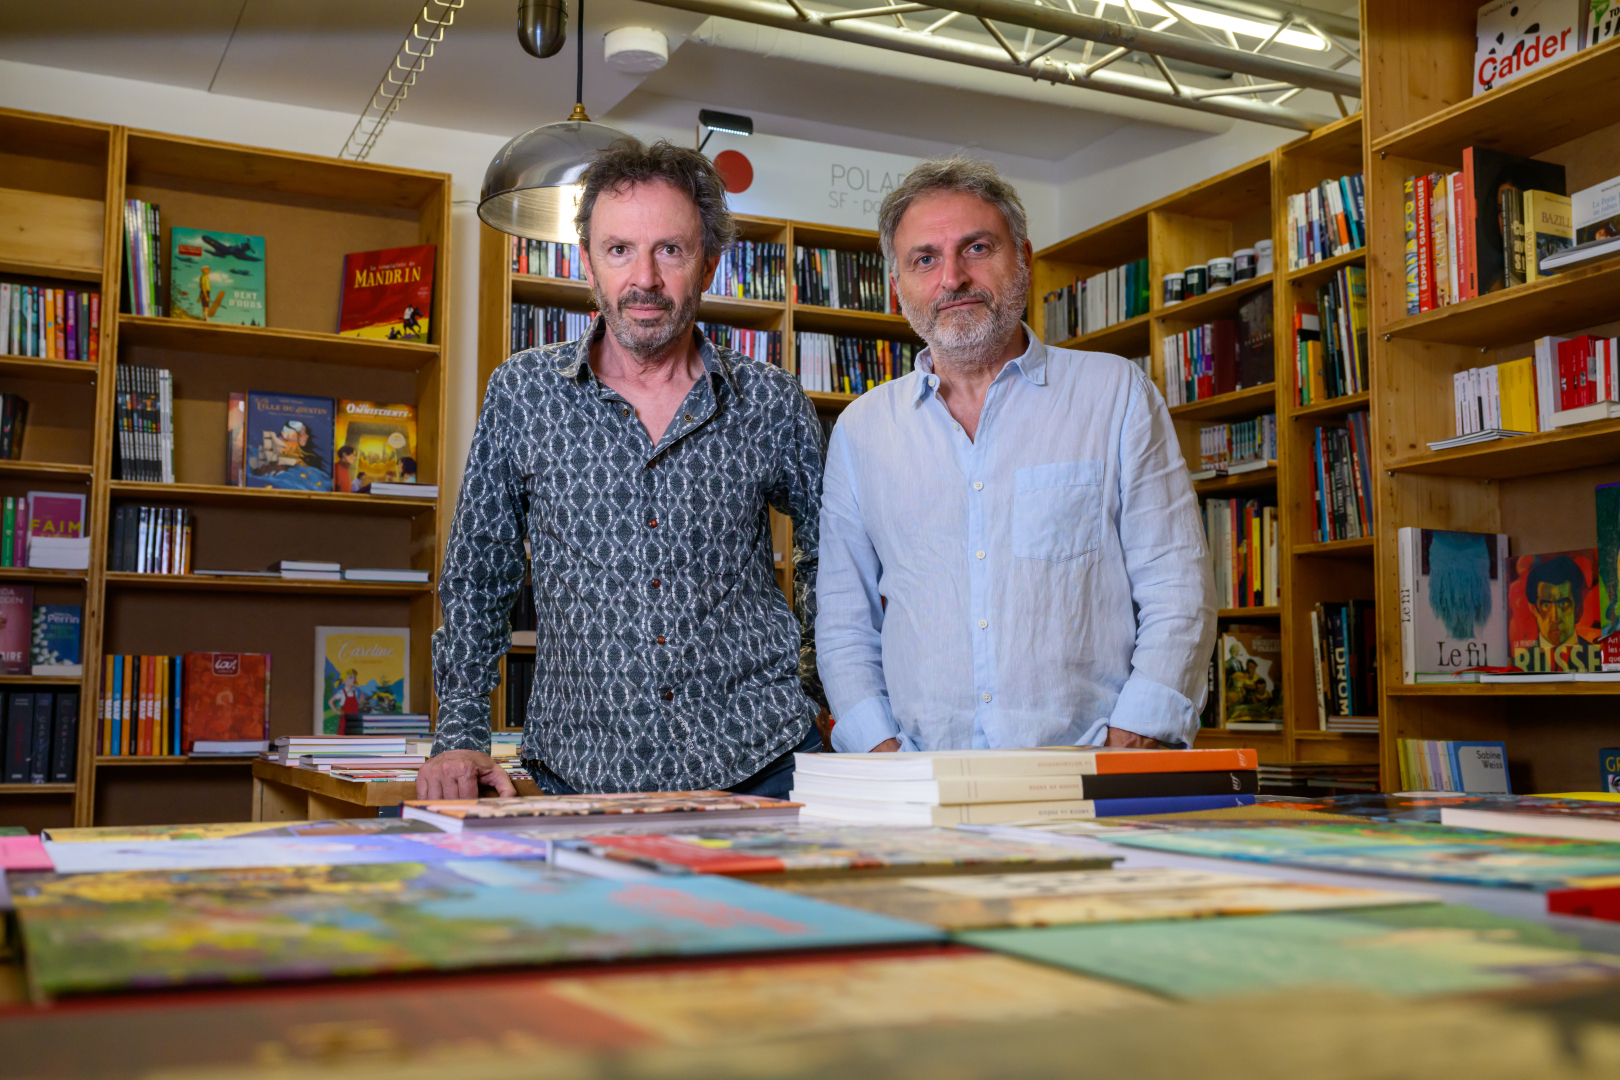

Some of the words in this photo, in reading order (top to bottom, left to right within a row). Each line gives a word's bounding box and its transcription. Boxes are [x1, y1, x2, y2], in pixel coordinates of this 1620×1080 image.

[1478, 27, 1572, 87] Calder
[829, 191, 849, 208] SF
[1417, 179, 1427, 245] GRAPHIQUES
[1404, 180, 1416, 302] VALADON
[1435, 219, 1446, 268] KLIMT
[354, 266, 421, 288] MANDRIN
[1418, 246, 1428, 291] ÉPOPÉES
[346, 403, 409, 418] OMNISCIENTS
[30, 519, 82, 534] FAIM
[47, 614, 80, 624] Perrin
[1401, 607, 1411, 623] Le
[1607, 636, 1619, 644] Art
[1608, 645, 1617, 653] les
[337, 639, 395, 662] Caroline
[1437, 641, 1462, 667] Le
[1465, 641, 1489, 667] fil
[1514, 645, 1601, 673] RUSSE
[105, 699, 113, 720] AYA
[112, 700, 121, 721] AYA
[122, 700, 131, 720] AYA
[139, 700, 147, 720] AYA
[1476, 750, 1502, 761] Sabine
[1481, 759, 1502, 769] Weiss
